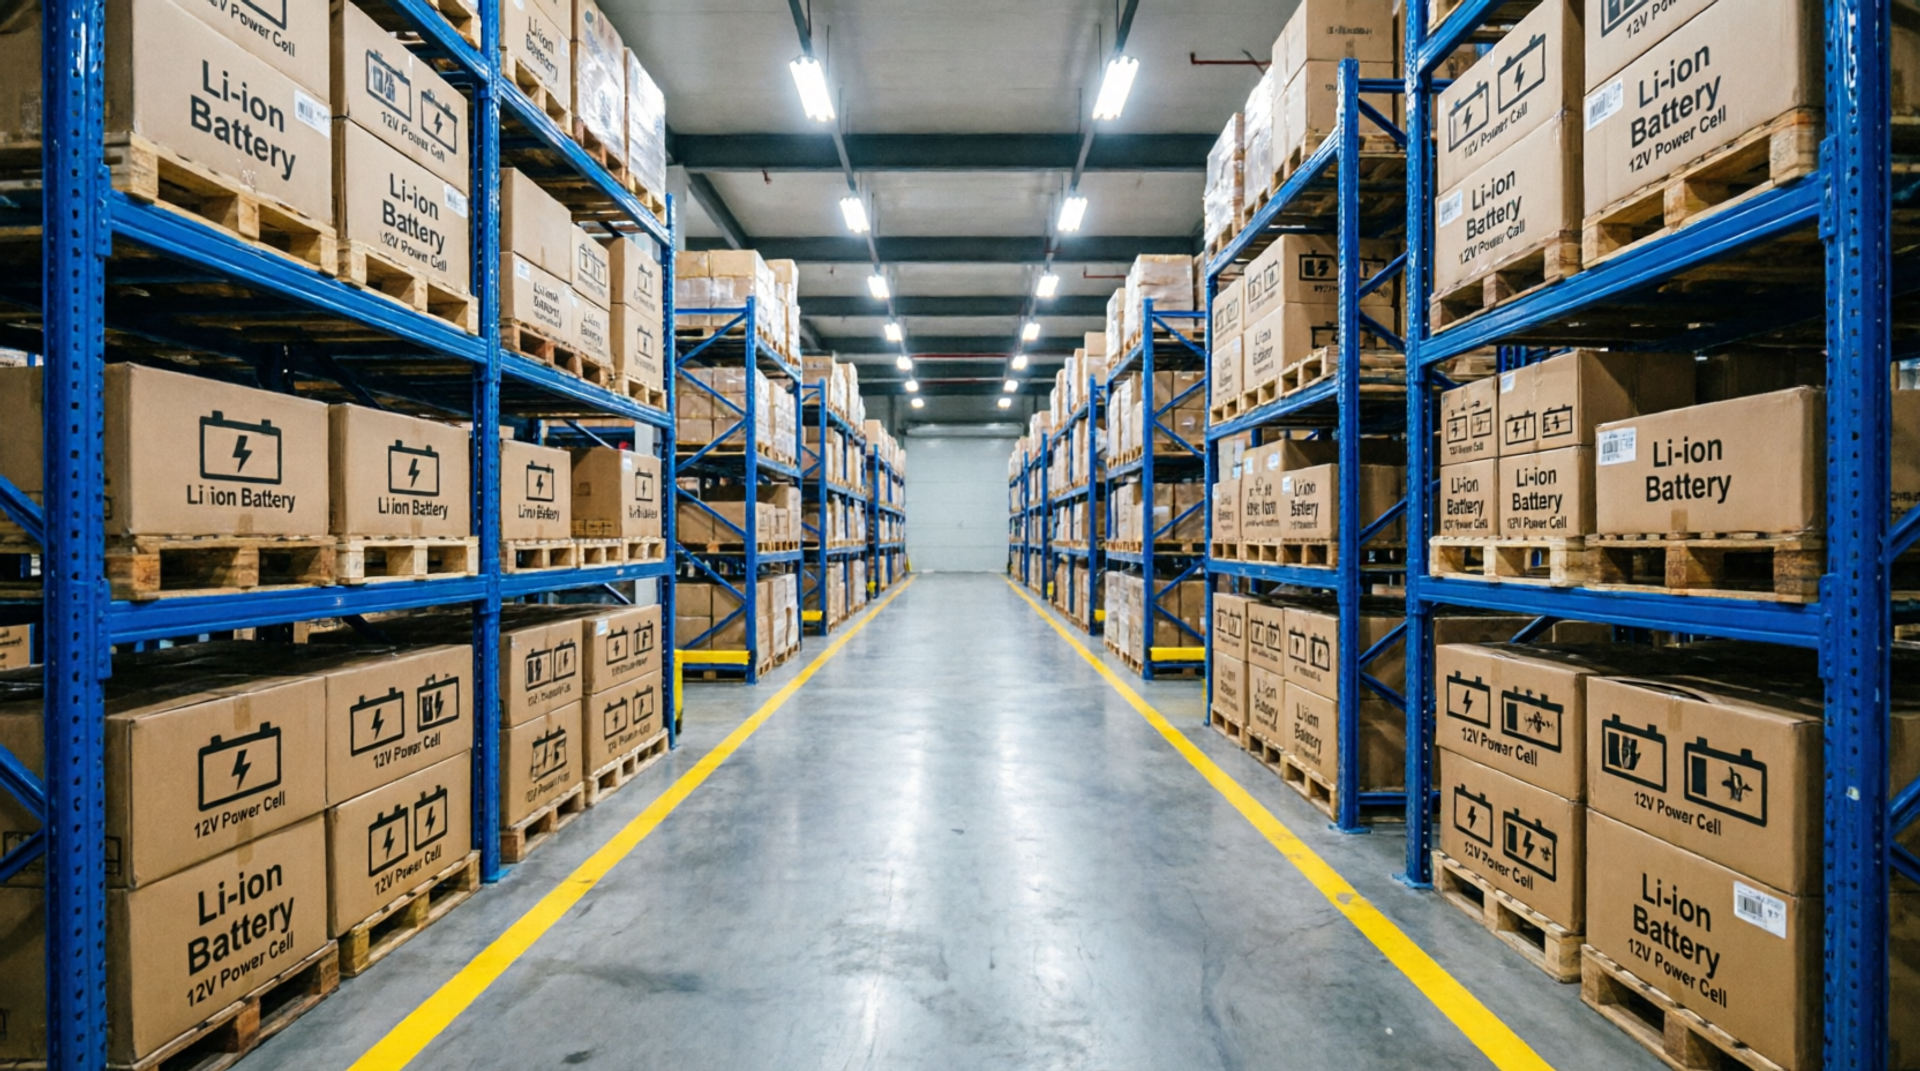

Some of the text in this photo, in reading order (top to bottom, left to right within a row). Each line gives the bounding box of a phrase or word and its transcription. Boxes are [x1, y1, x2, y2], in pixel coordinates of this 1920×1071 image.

[203, 59, 284, 132] Li-ion
[1639, 45, 1710, 108] Li-ion
[1631, 75, 1721, 148] Battery
[191, 94, 296, 181] Battery
[1629, 105, 1726, 173] 12V Power Cell
[390, 172, 439, 220] Li-ion
[1472, 170, 1515, 211] Li-ion
[382, 199, 445, 255] Battery
[1466, 196, 1522, 241] Battery
[1653, 436, 1722, 468] Li-ion
[241, 487, 295, 513] Battery
[1517, 467, 1557, 488] Li-ion
[1646, 473, 1731, 504] Battery
[412, 499, 448, 520] Battery
[1512, 493, 1563, 514] Battery
[1461, 726, 1479, 744] 12V
[1515, 744, 1538, 767] Cell
[194, 791, 286, 838] 12V Power Cell
[1633, 791, 1722, 836] 12V Power Cell
[198, 864, 283, 926] Li-ion
[374, 870, 394, 896] 12V
[1642, 872, 1711, 933] Li-ion
[188, 897, 294, 977] Battery
[1633, 903, 1720, 980] Battery
[186, 931, 294, 1007] 12V Power Cell
[1627, 938, 1728, 1009] 12V Power Cell
